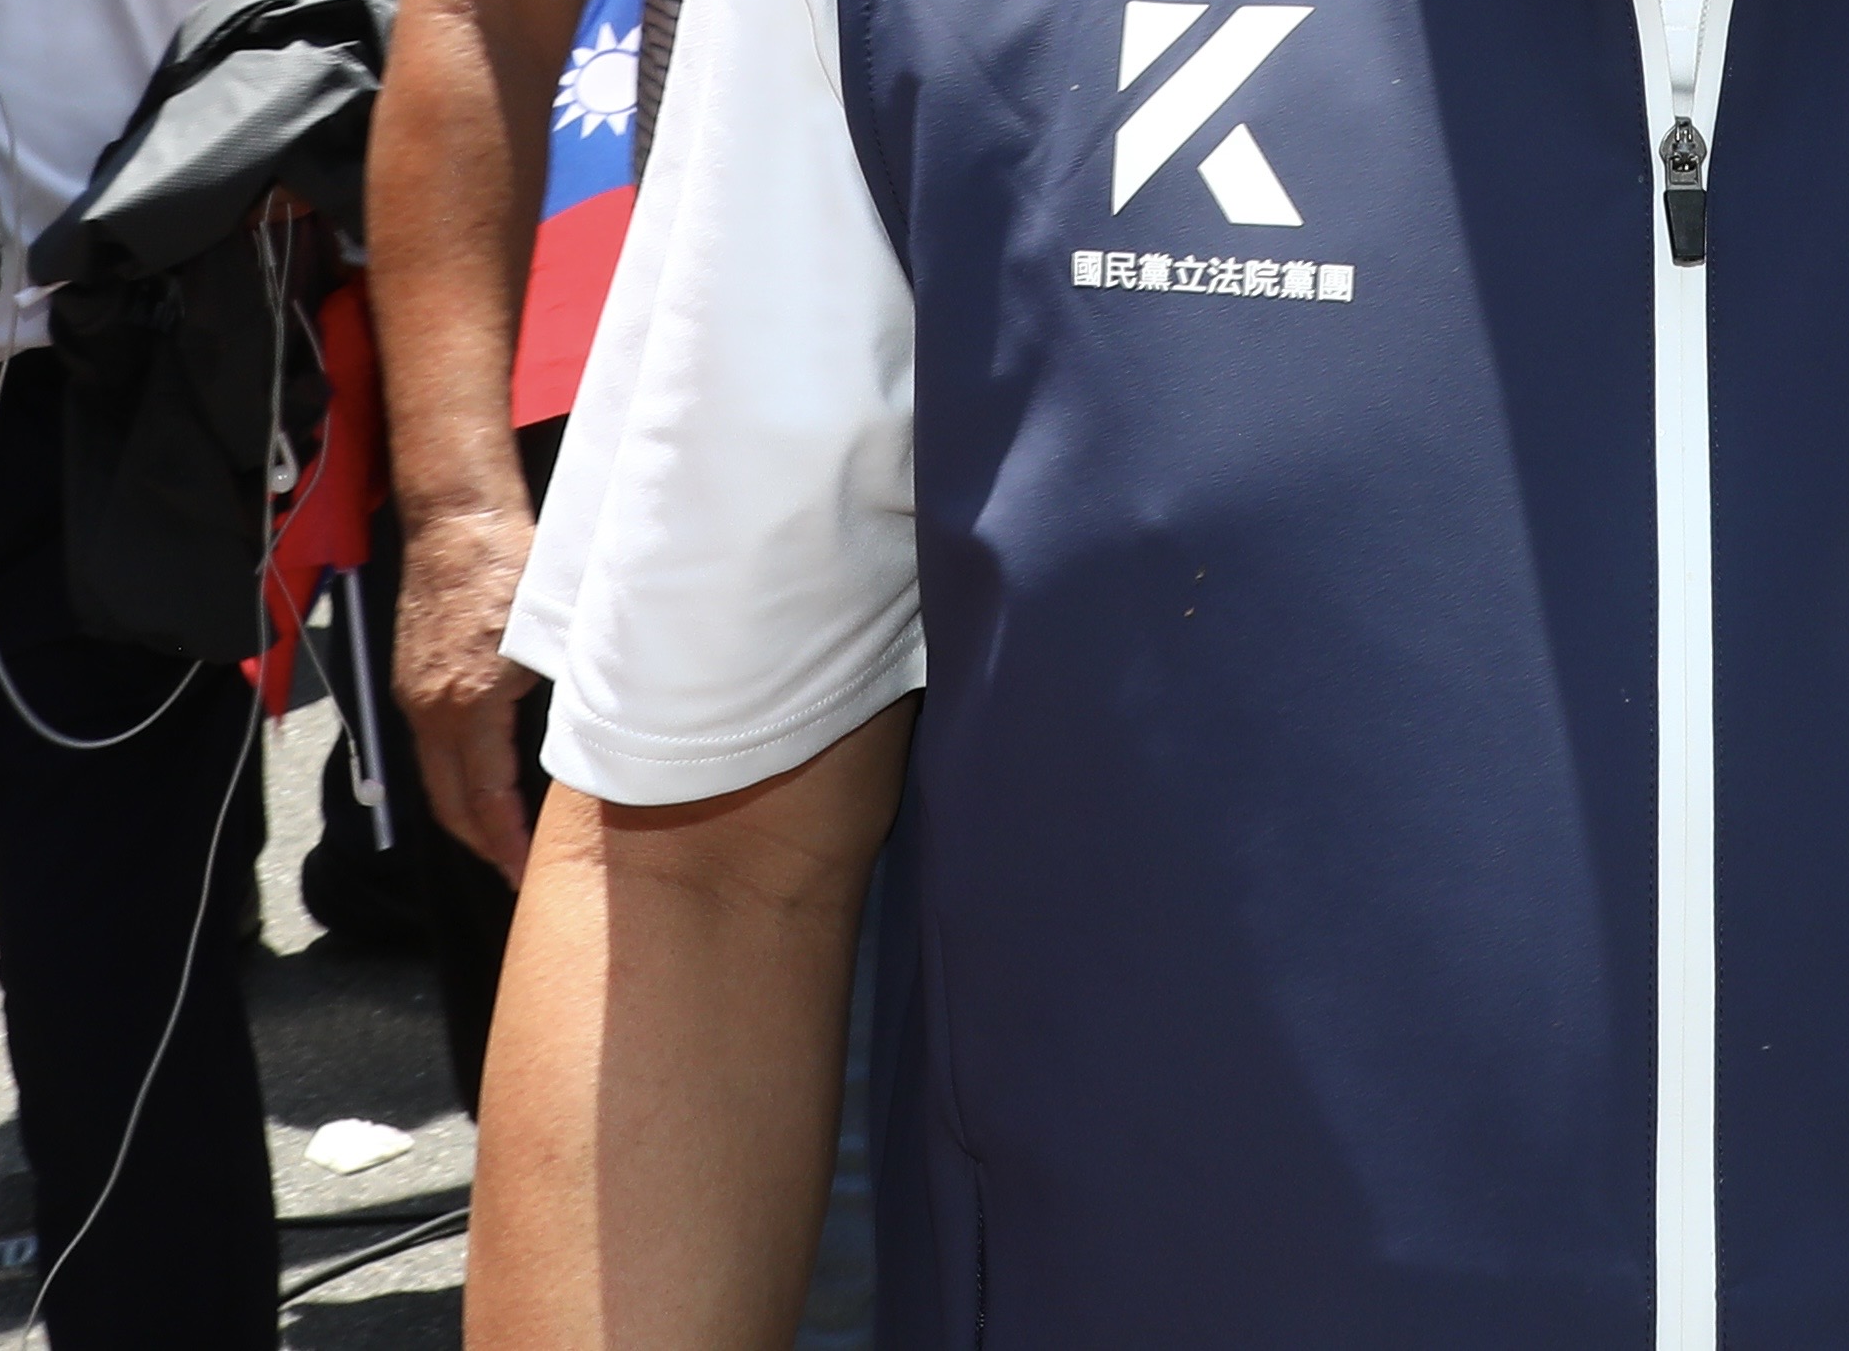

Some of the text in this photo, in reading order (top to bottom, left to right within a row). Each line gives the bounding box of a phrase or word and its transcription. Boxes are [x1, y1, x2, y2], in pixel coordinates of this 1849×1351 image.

[1071, 249, 1355, 302] 國民黨立法院黨團
